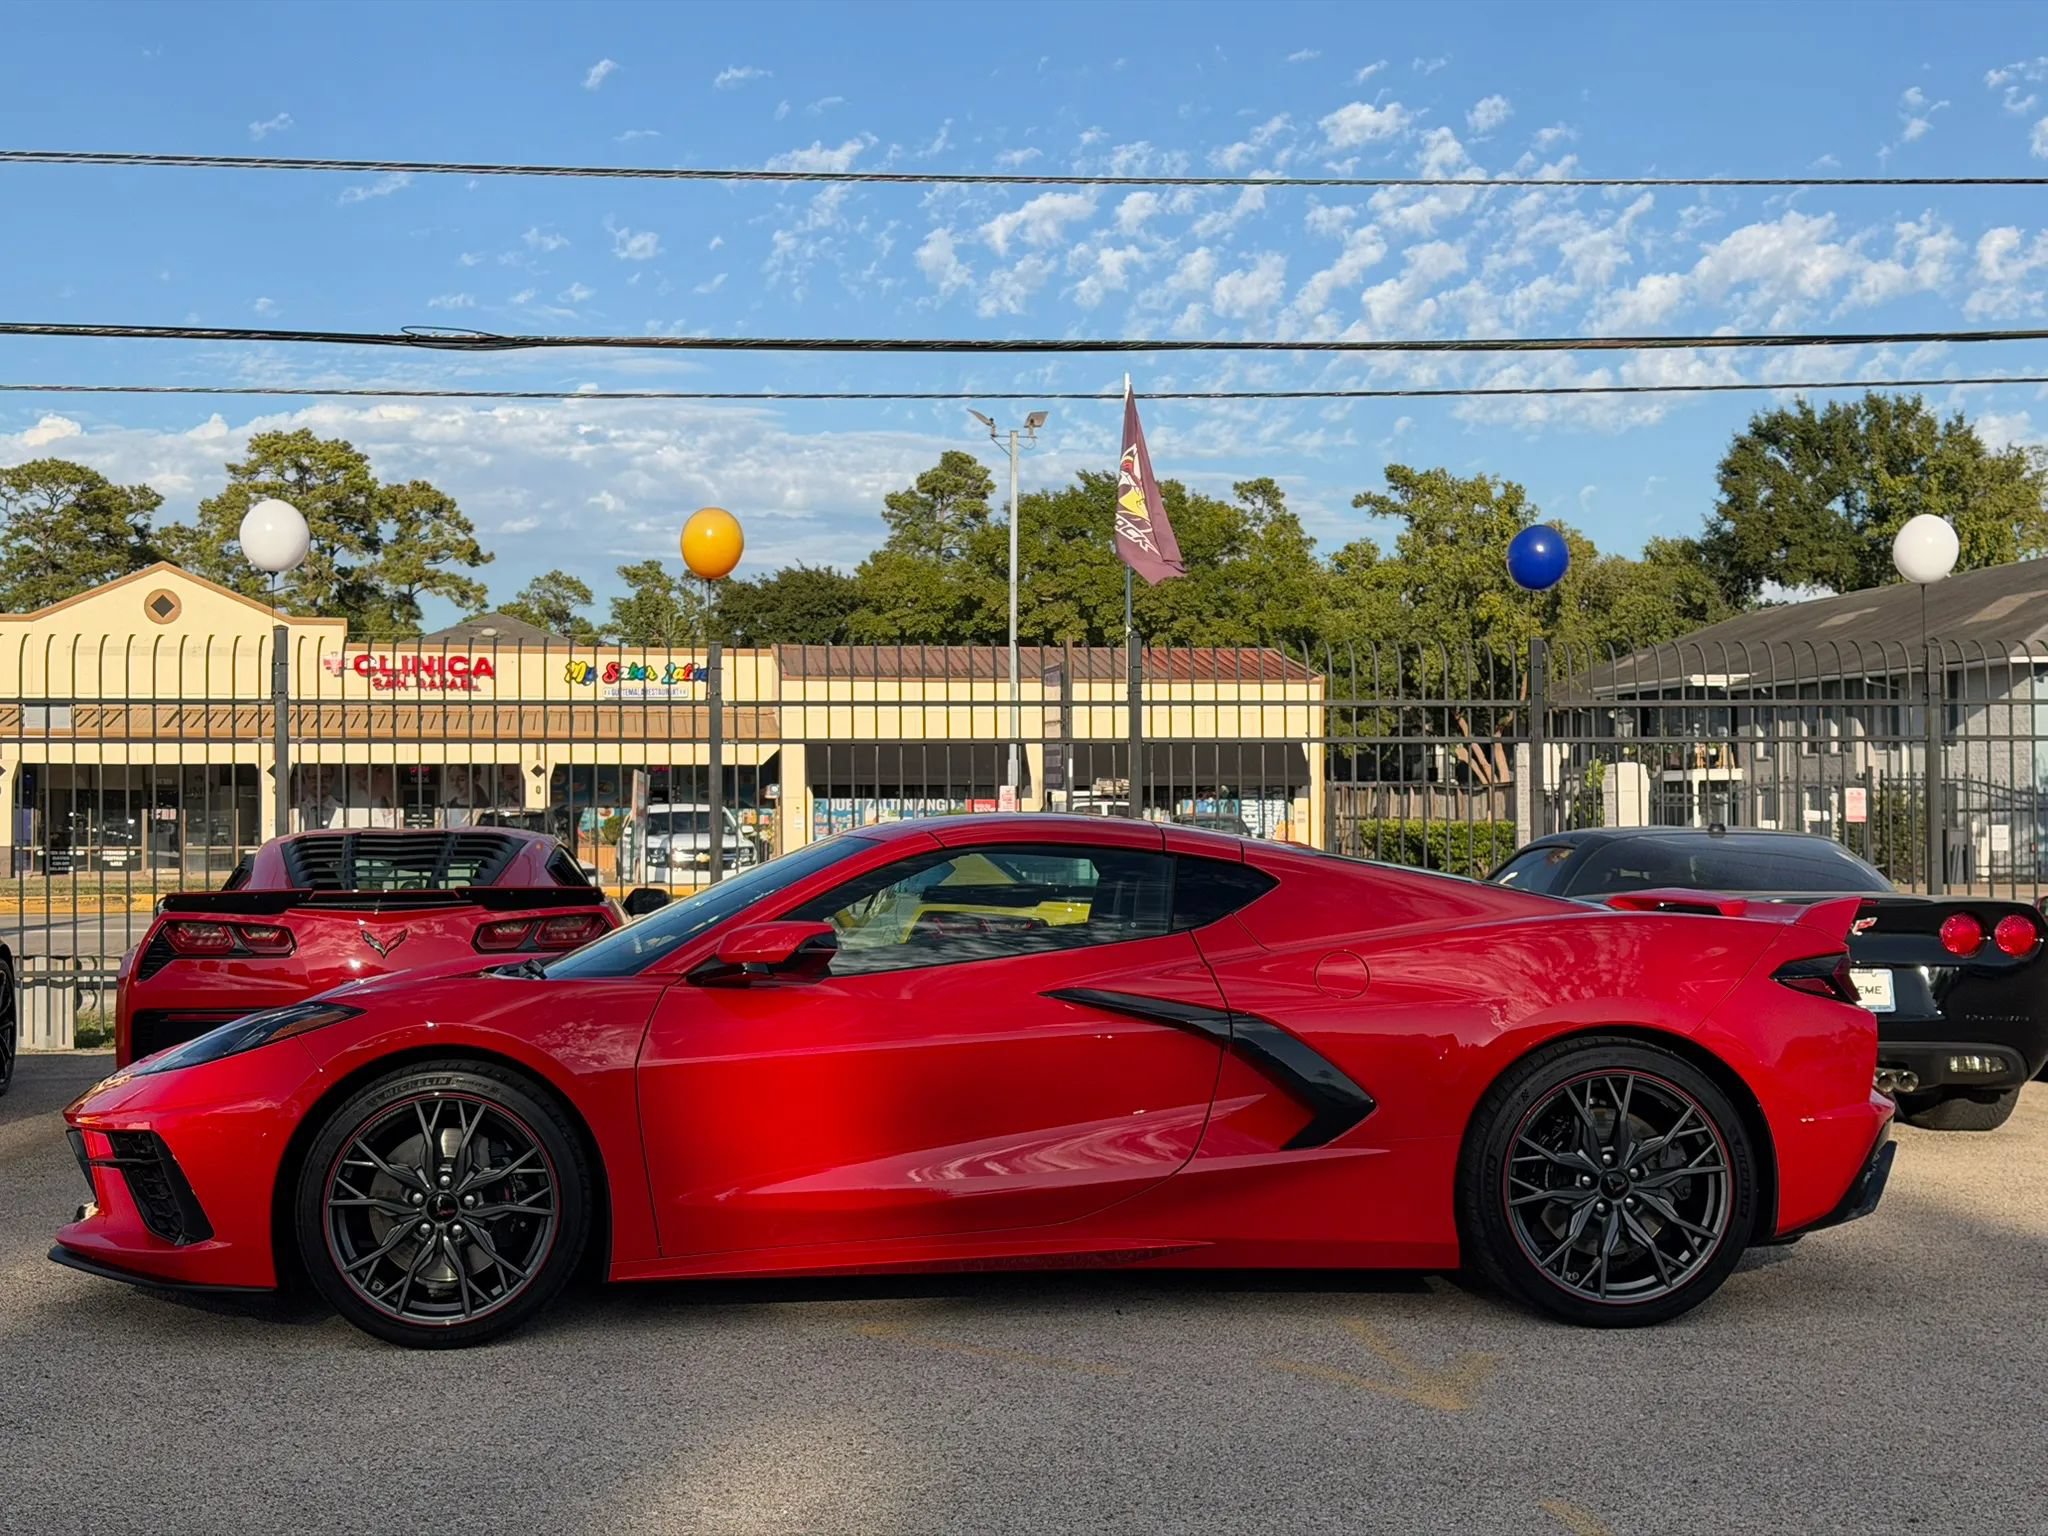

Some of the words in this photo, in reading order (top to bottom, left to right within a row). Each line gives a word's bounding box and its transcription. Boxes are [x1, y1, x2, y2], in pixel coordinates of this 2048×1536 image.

[353, 654, 495, 678] CLINICA
[564, 660, 598, 686] My
[602, 661, 658, 684] Sabor
[372, 677, 409, 691] SAN
[611, 688, 644, 697] GUTEMALA
[645, 688, 679, 697] ESTAURNT
[384, 1077, 448, 1098] MICHELIN
